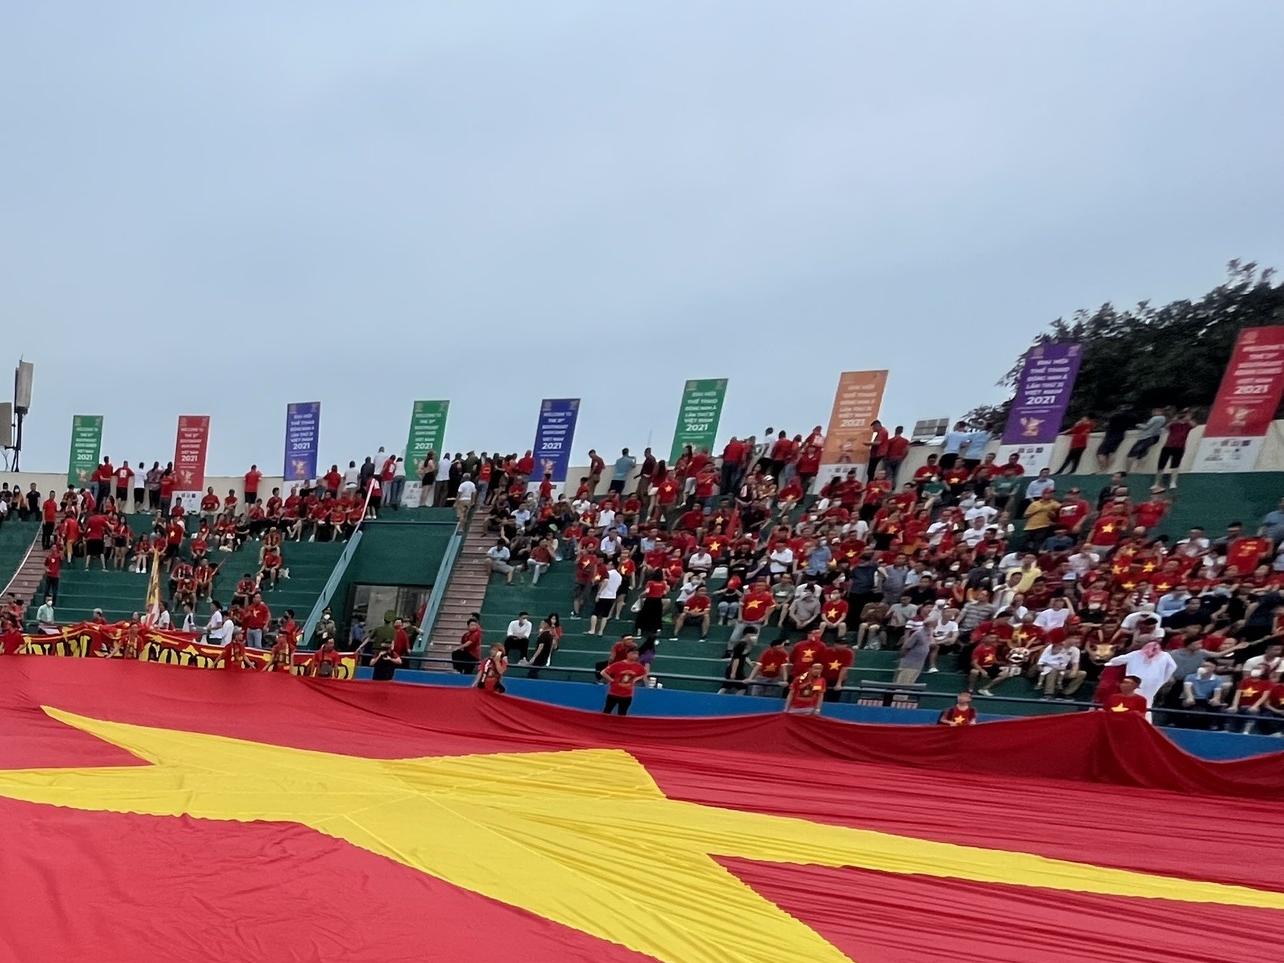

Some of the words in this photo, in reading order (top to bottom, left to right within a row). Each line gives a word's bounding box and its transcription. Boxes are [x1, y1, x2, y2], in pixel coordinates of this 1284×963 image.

[1233, 384, 1270, 394] 2021
[1025, 395, 1056, 405] 2021
[840, 419, 866, 427] 2021
[293, 442, 310, 450] 2021
